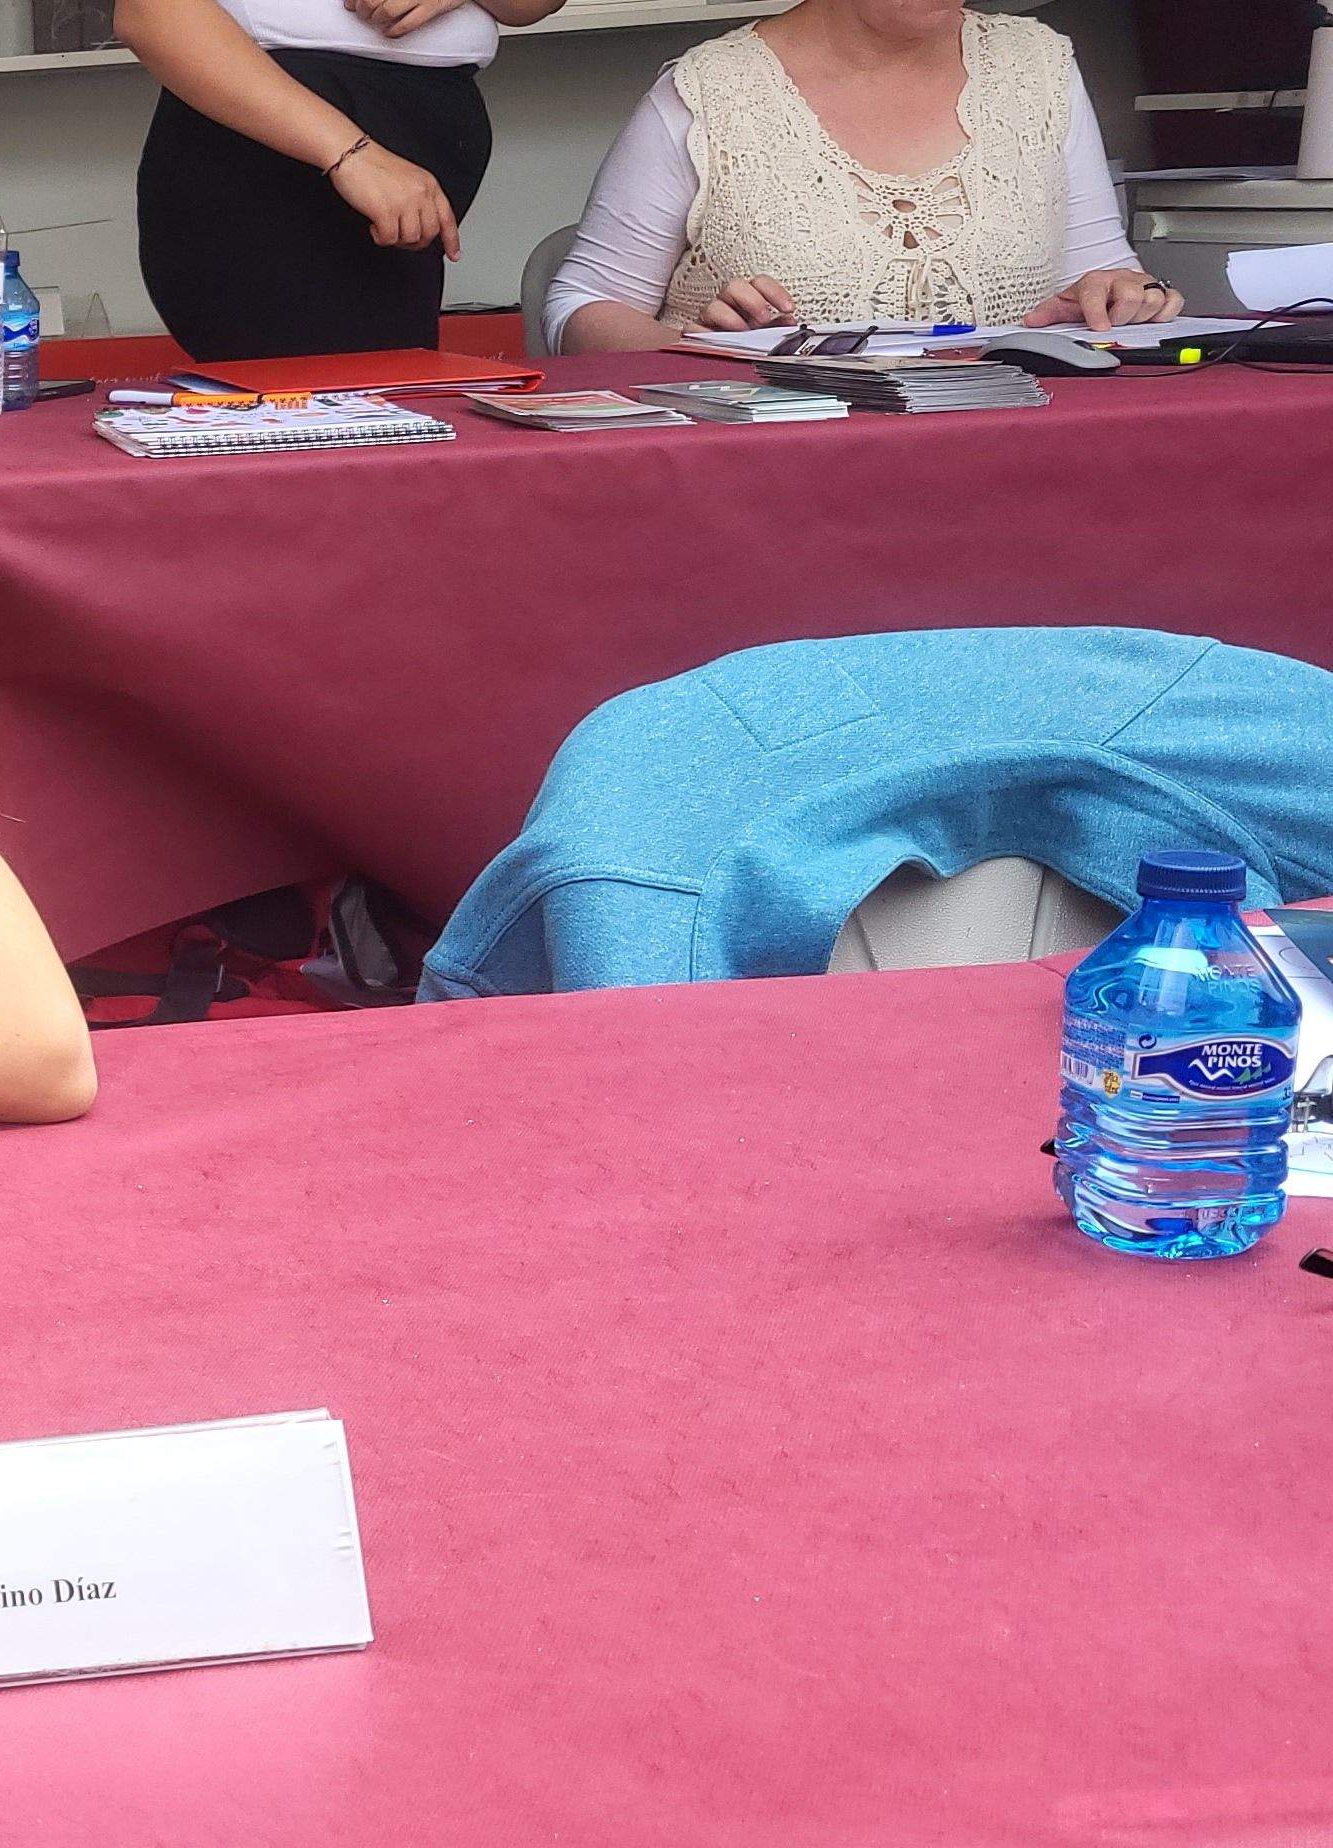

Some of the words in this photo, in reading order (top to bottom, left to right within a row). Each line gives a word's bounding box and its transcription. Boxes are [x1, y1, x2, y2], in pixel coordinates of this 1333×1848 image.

[1202, 1044, 1263, 1055] MONTE
[1208, 1056, 1261, 1067] PINOS
[52, 1577, 117, 1604] Díaz
